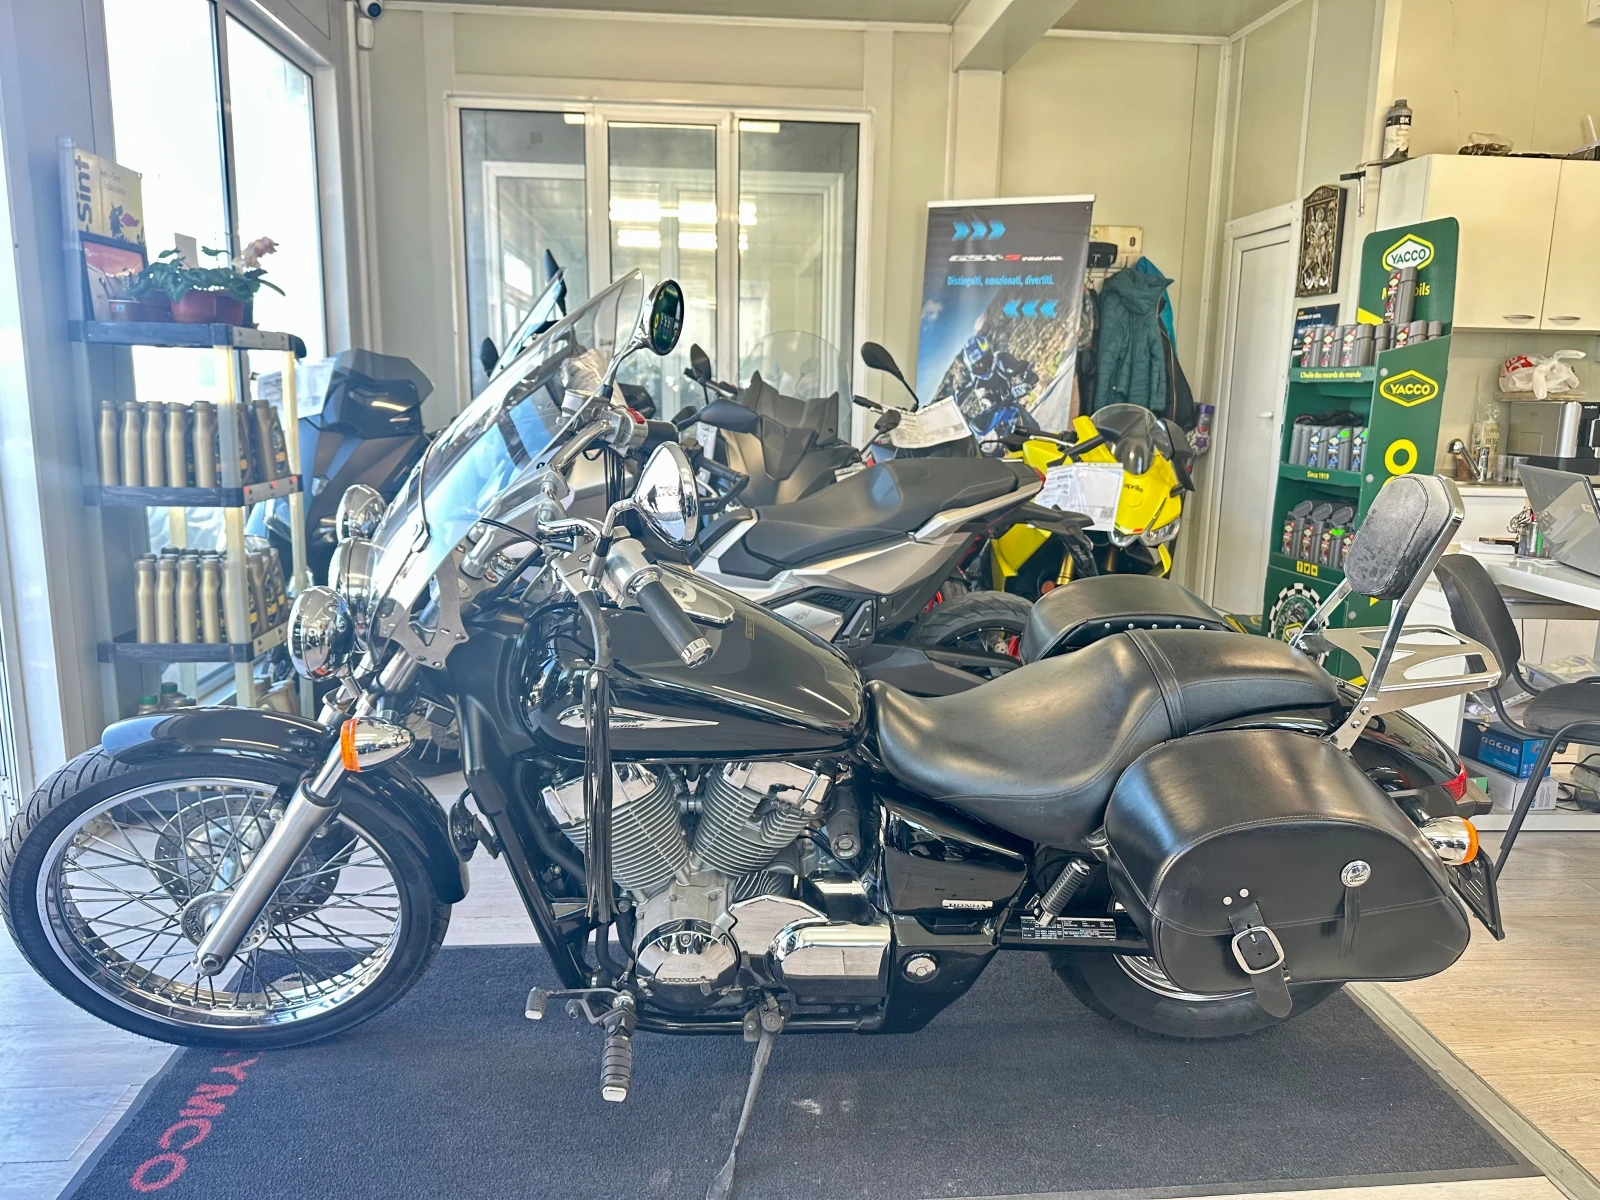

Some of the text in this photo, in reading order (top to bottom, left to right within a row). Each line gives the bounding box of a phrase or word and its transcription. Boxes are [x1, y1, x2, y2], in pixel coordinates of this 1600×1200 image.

[1390, 249, 1427, 264] YACCO
[984, 274, 1024, 287] emozionati,
[1389, 382, 1431, 396] YACCO
[1318, 472, 1330, 480] 1919
[130, 1050, 265, 1193] YMCO
